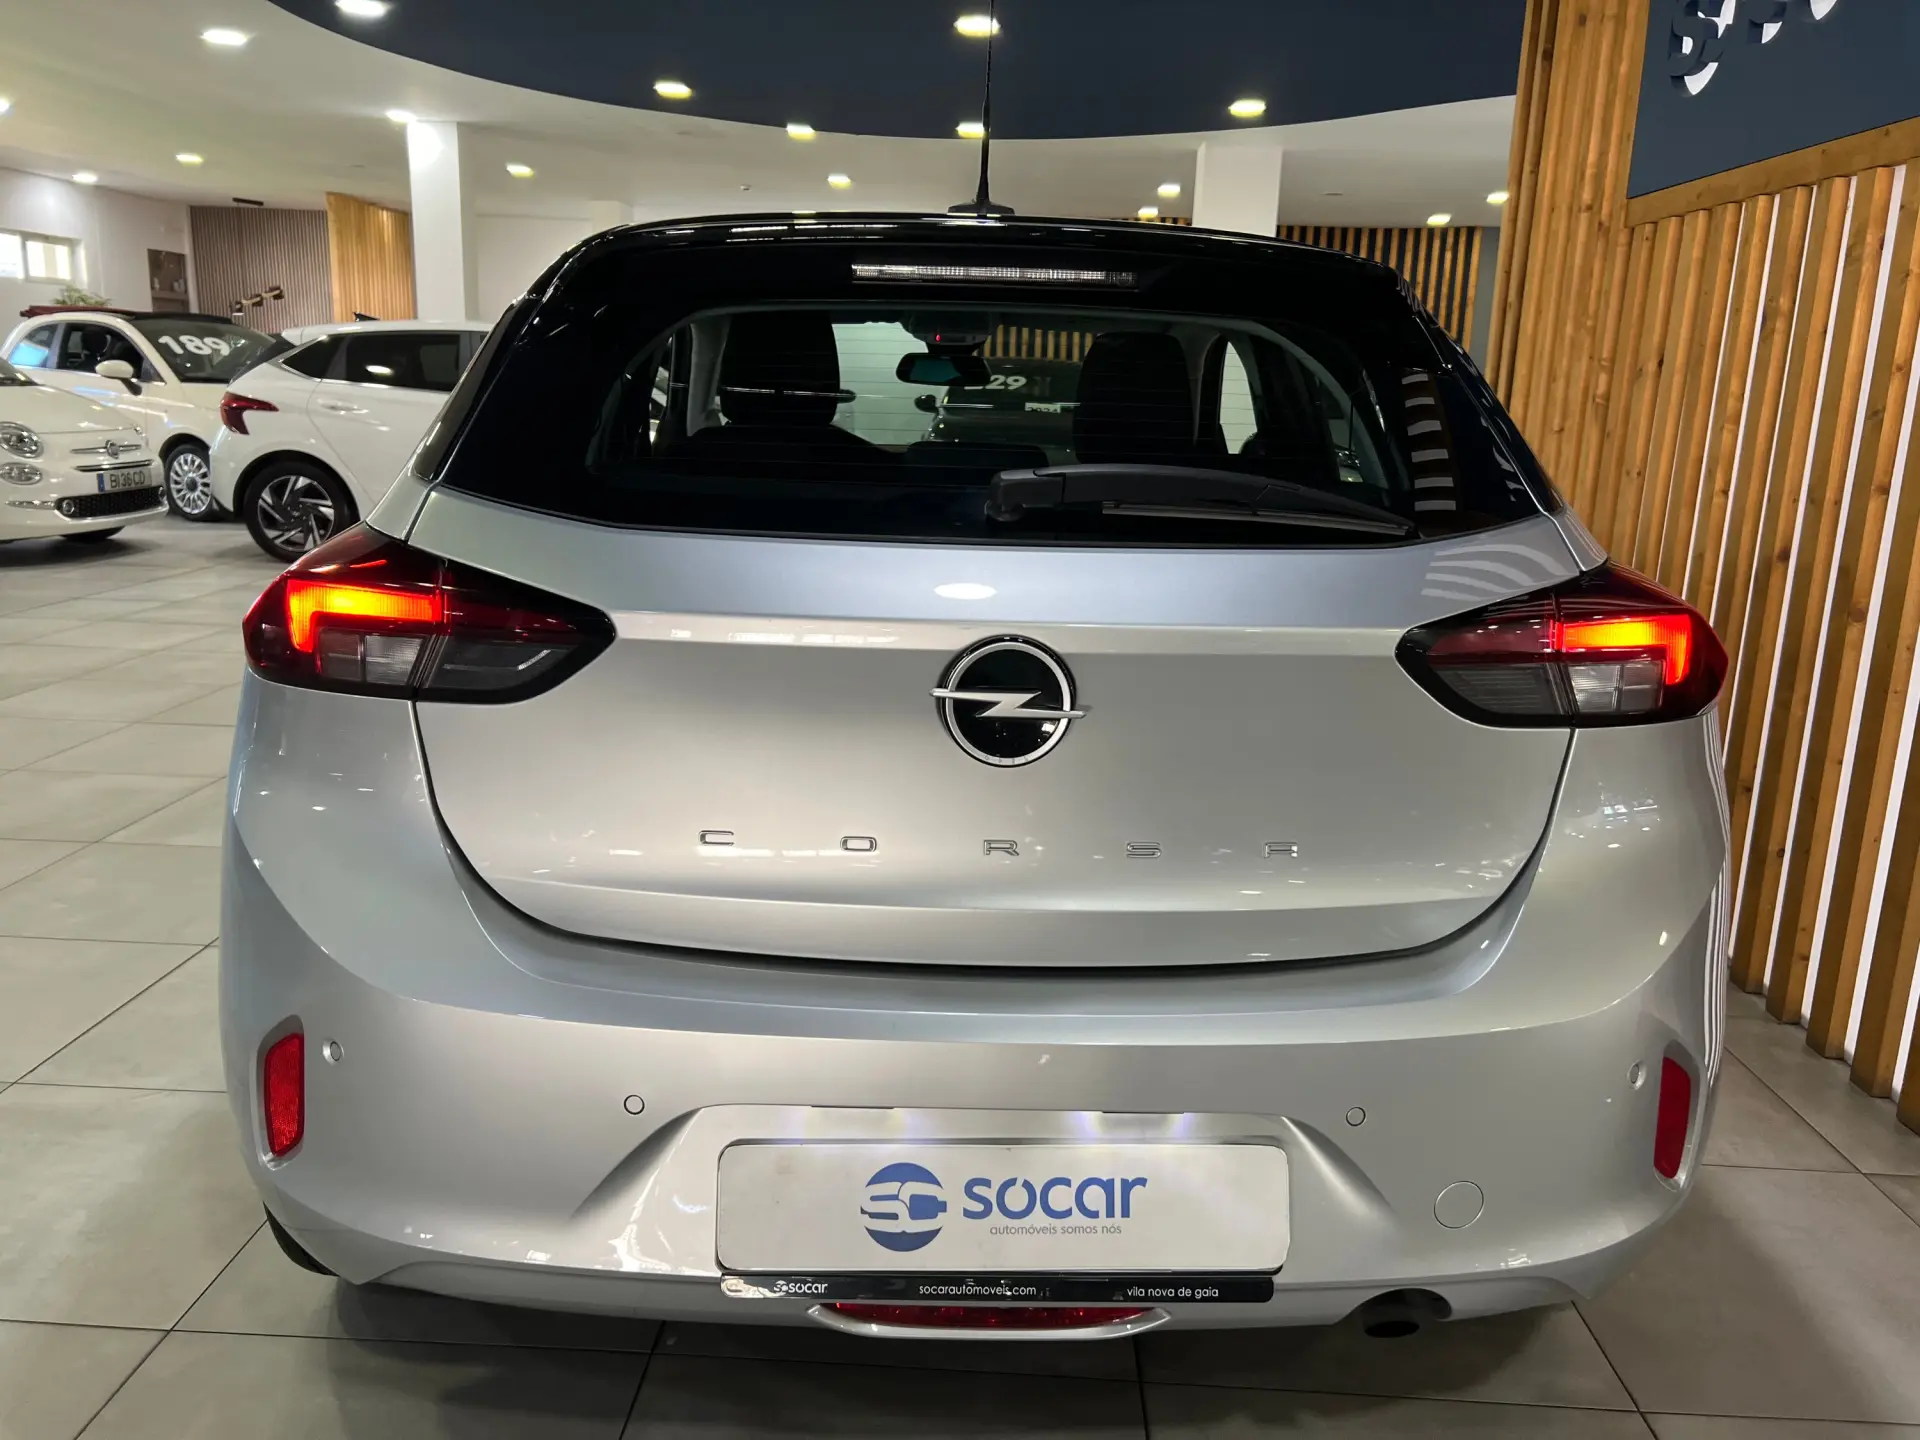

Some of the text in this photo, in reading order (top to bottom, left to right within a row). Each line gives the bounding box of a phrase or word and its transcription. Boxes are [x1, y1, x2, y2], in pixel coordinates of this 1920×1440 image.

[158, 335, 230, 356] 189
[963, 374, 1028, 390] 29
[699, 829, 1299, 859] CORSA
[962, 1176, 1148, 1220] socar
[989, 1222, 1122, 1235] automóveis somos nós
[788, 1282, 828, 1293] socar
[919, 1284, 1037, 1296] socarautomoveis.com
[1127, 1286, 1219, 1299] vila nova de gaia
